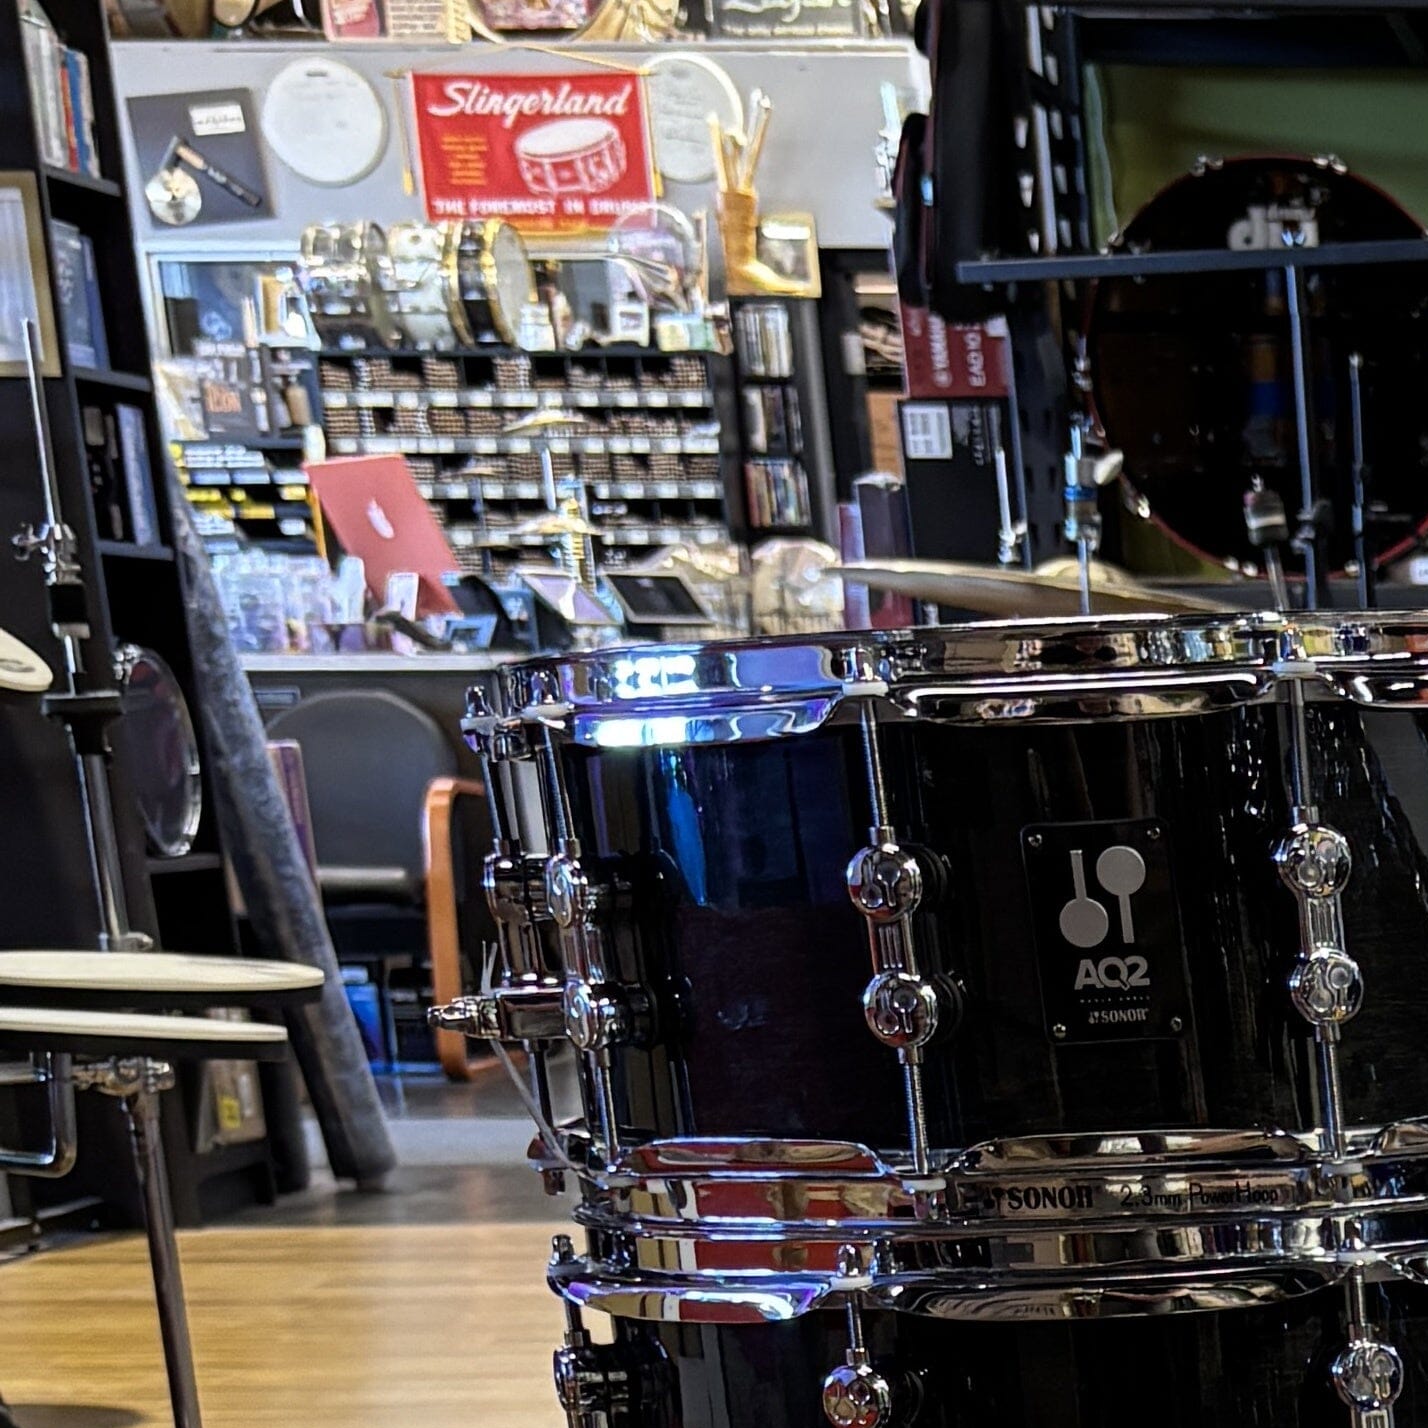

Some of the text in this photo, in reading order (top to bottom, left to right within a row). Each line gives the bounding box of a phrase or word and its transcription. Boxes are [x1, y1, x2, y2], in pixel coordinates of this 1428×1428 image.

[427, 78, 633, 129] Slingerland
[1074, 955, 1151, 991] AQ2
[1007, 1184, 1094, 1210] SONOR
